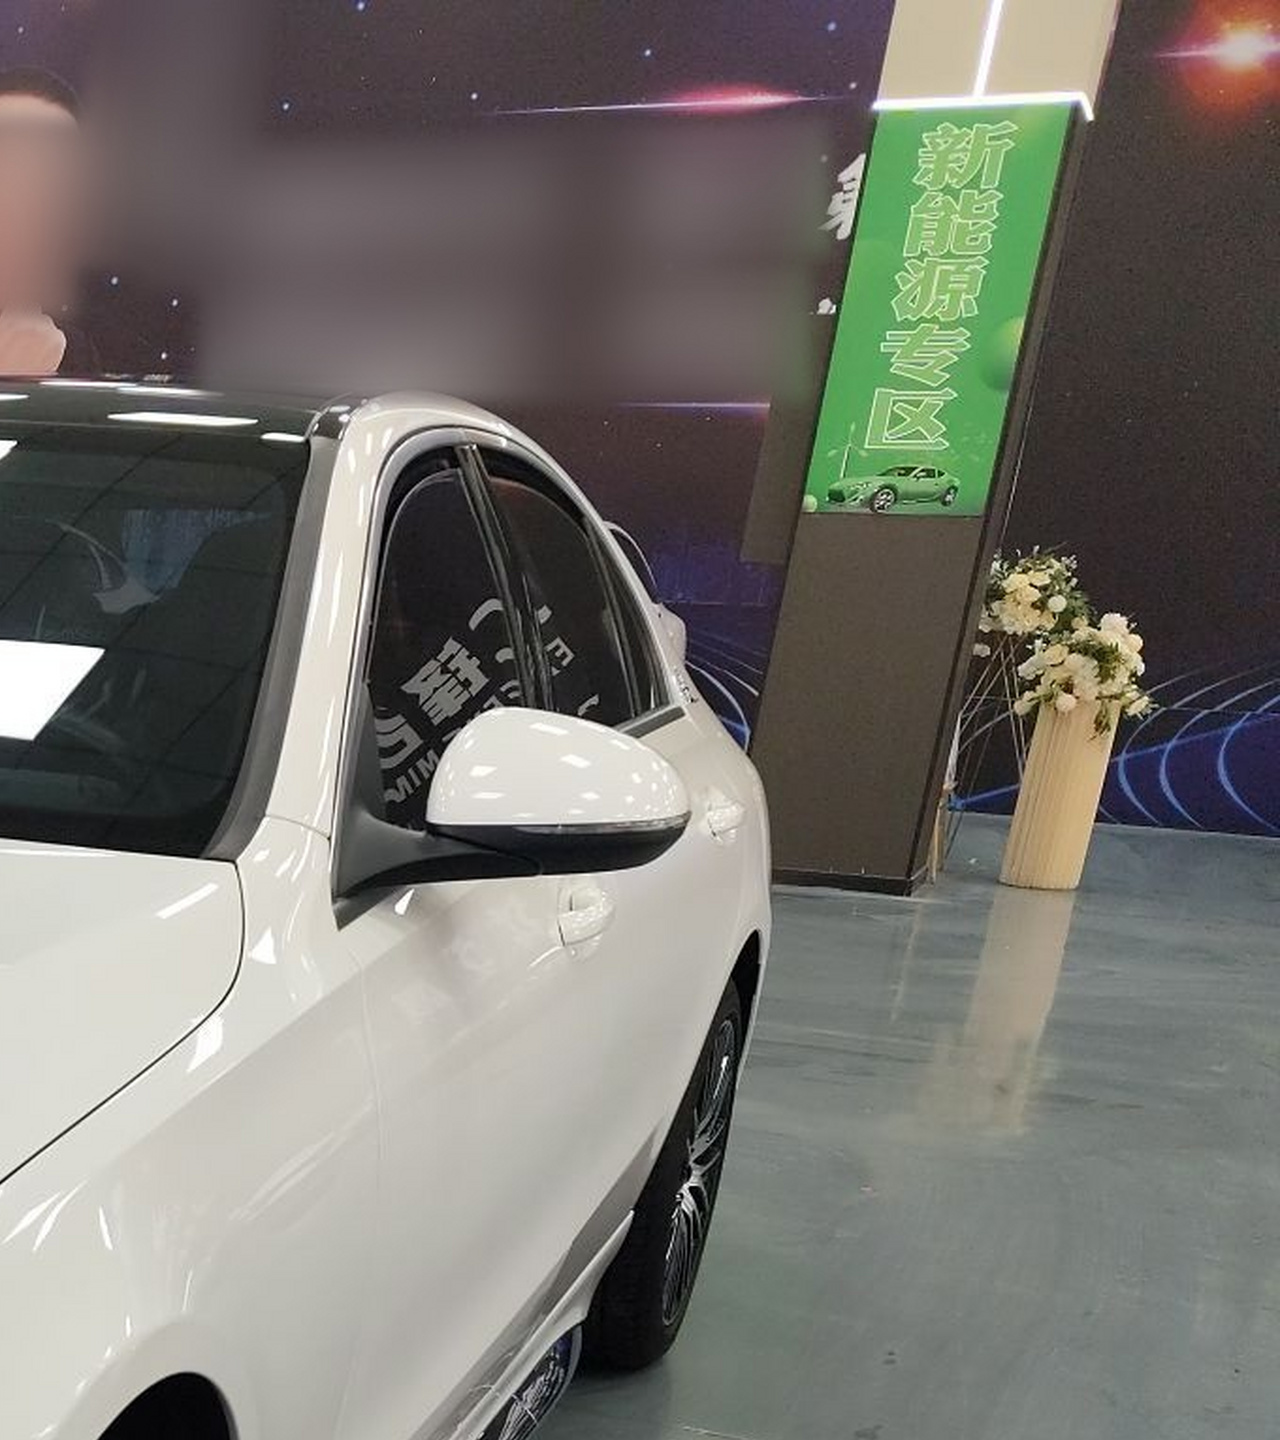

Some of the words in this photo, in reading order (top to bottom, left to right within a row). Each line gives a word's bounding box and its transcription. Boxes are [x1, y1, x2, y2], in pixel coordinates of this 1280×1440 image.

[864, 121, 1018, 451] 新能源专区
